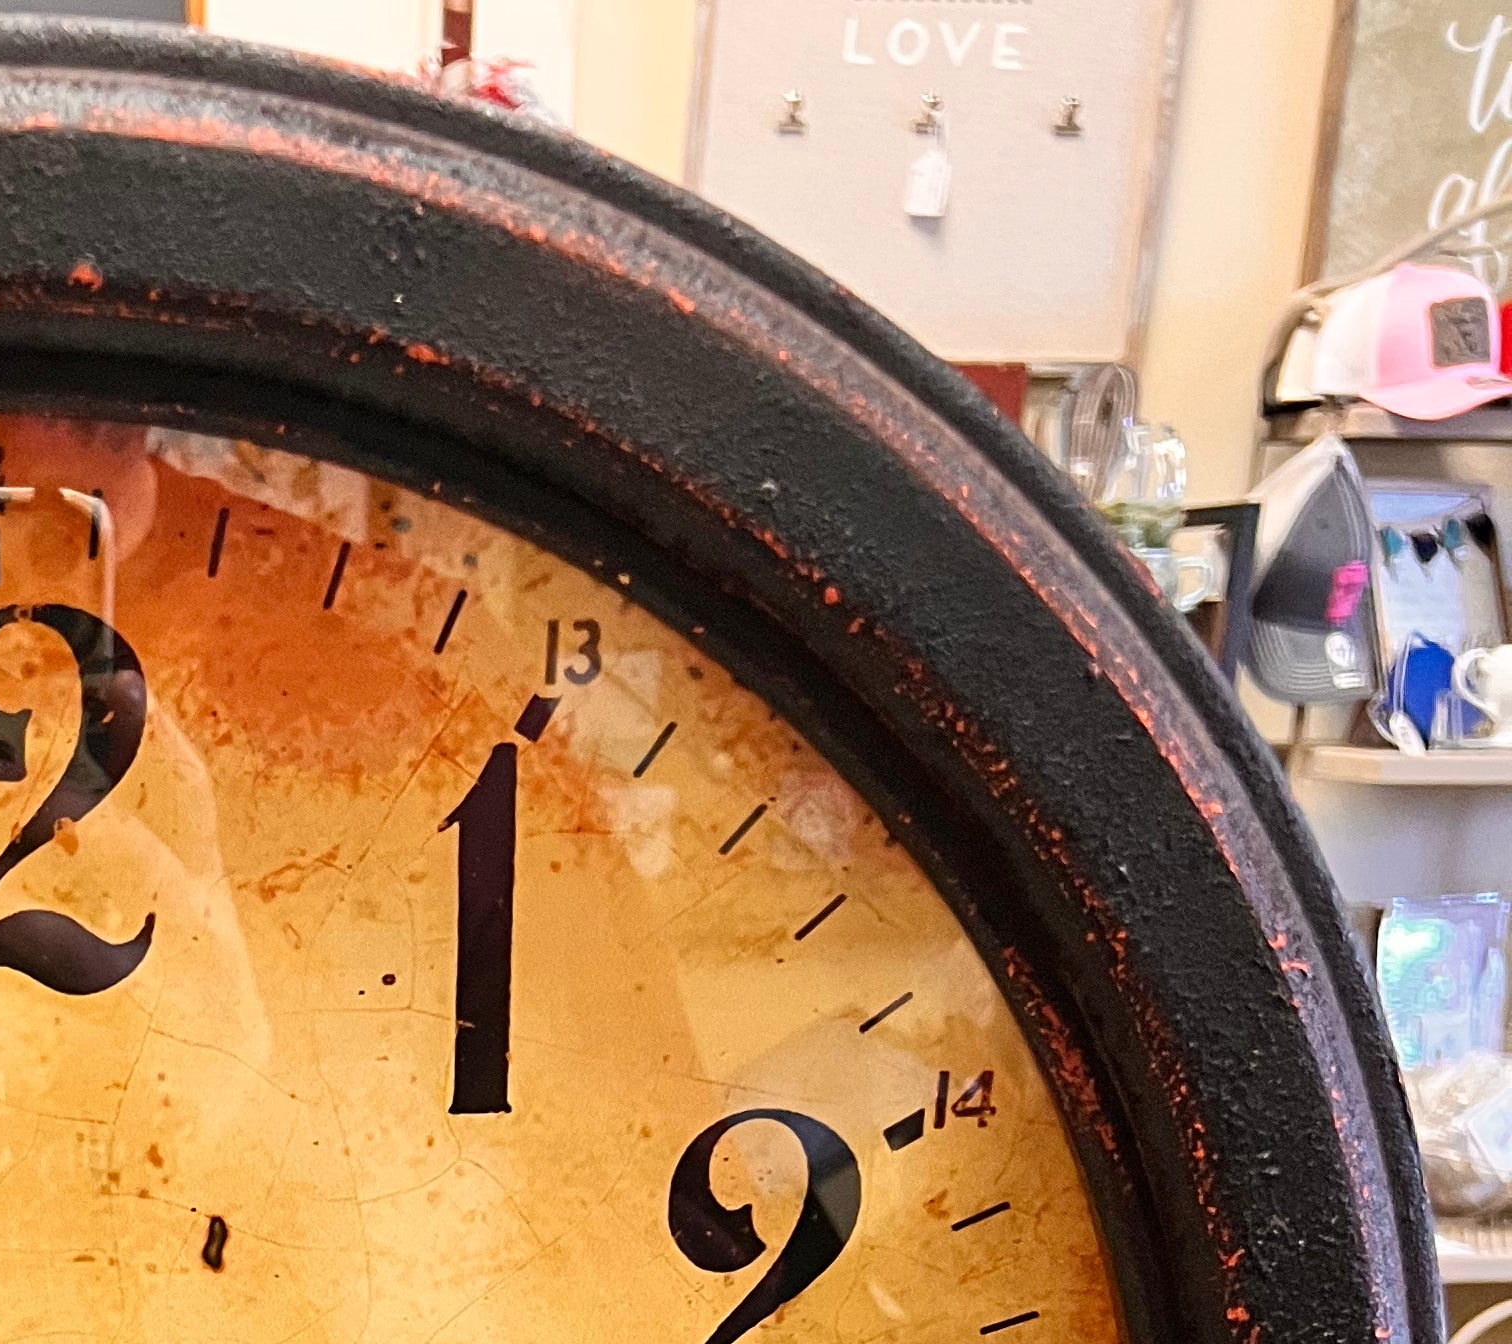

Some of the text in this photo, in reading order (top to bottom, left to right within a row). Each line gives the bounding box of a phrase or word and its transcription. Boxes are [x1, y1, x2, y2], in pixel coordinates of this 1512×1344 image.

[842, 18, 1031, 71] LOVE
[544, 619, 602, 686] 13
[437, 742, 518, 1113] 1
[933, 1070, 997, 1129] 14
